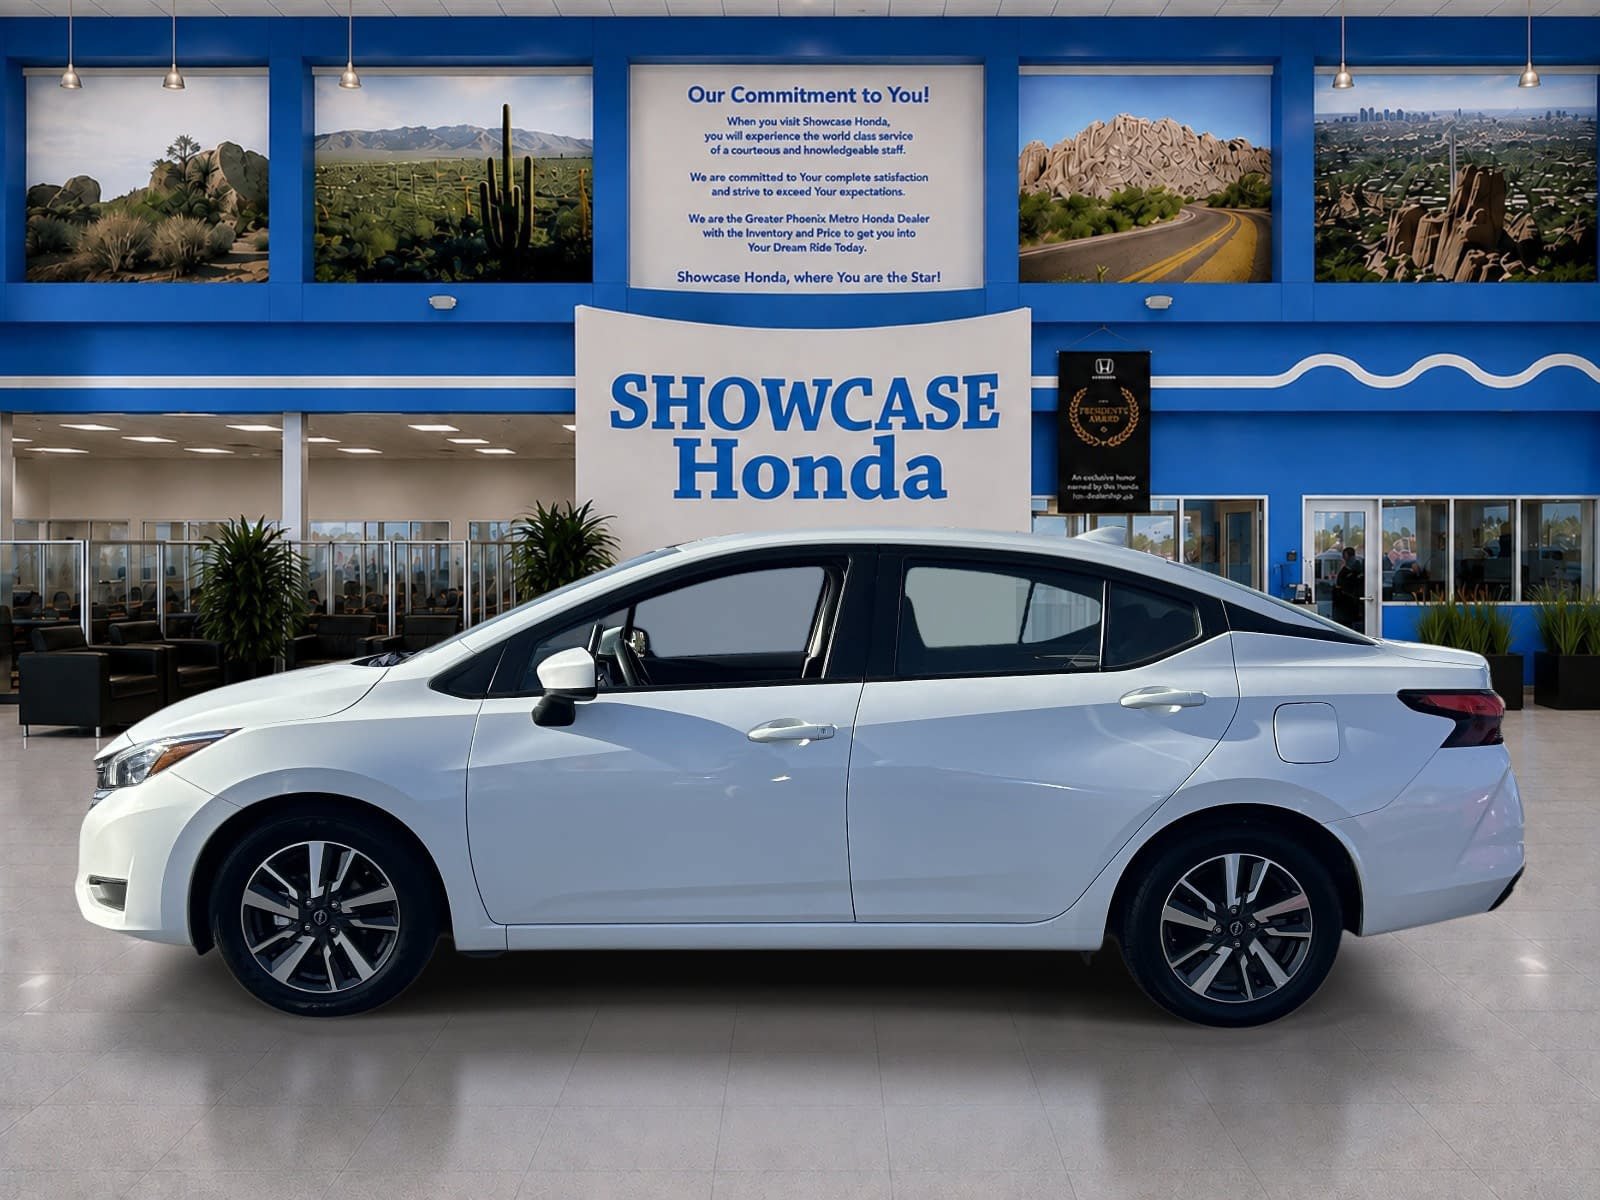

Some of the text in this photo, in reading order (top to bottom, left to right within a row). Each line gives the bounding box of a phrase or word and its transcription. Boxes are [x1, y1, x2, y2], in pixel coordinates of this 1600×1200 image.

[687, 85, 930, 104] Our Commitment to You!
[726, 116, 891, 129] When you visit Showcase Honda,
[704, 130, 914, 144] you will experience the world class service
[710, 144, 722, 155] of
[722, 147, 730, 155] a
[730, 146, 781, 155] courteous
[782, 144, 802, 155] and
[881, 144, 906, 155] staff.
[689, 171, 929, 185] We are committed to Your complete satisfaction
[711, 185, 906, 200] and strive to exceed Your expectations.
[688, 213, 931, 224] We are the Greater Phoenix Metro Honda Dealer
[702, 227, 917, 241] with the Inventory and Price to get you into
[747, 242, 868, 255] Your Dream Ride Today.
[677, 270, 941, 286] Showcase Honda, where You are the Star!
[610, 373, 1000, 432] SHOWCASE
[672, 433, 948, 501] Honda
